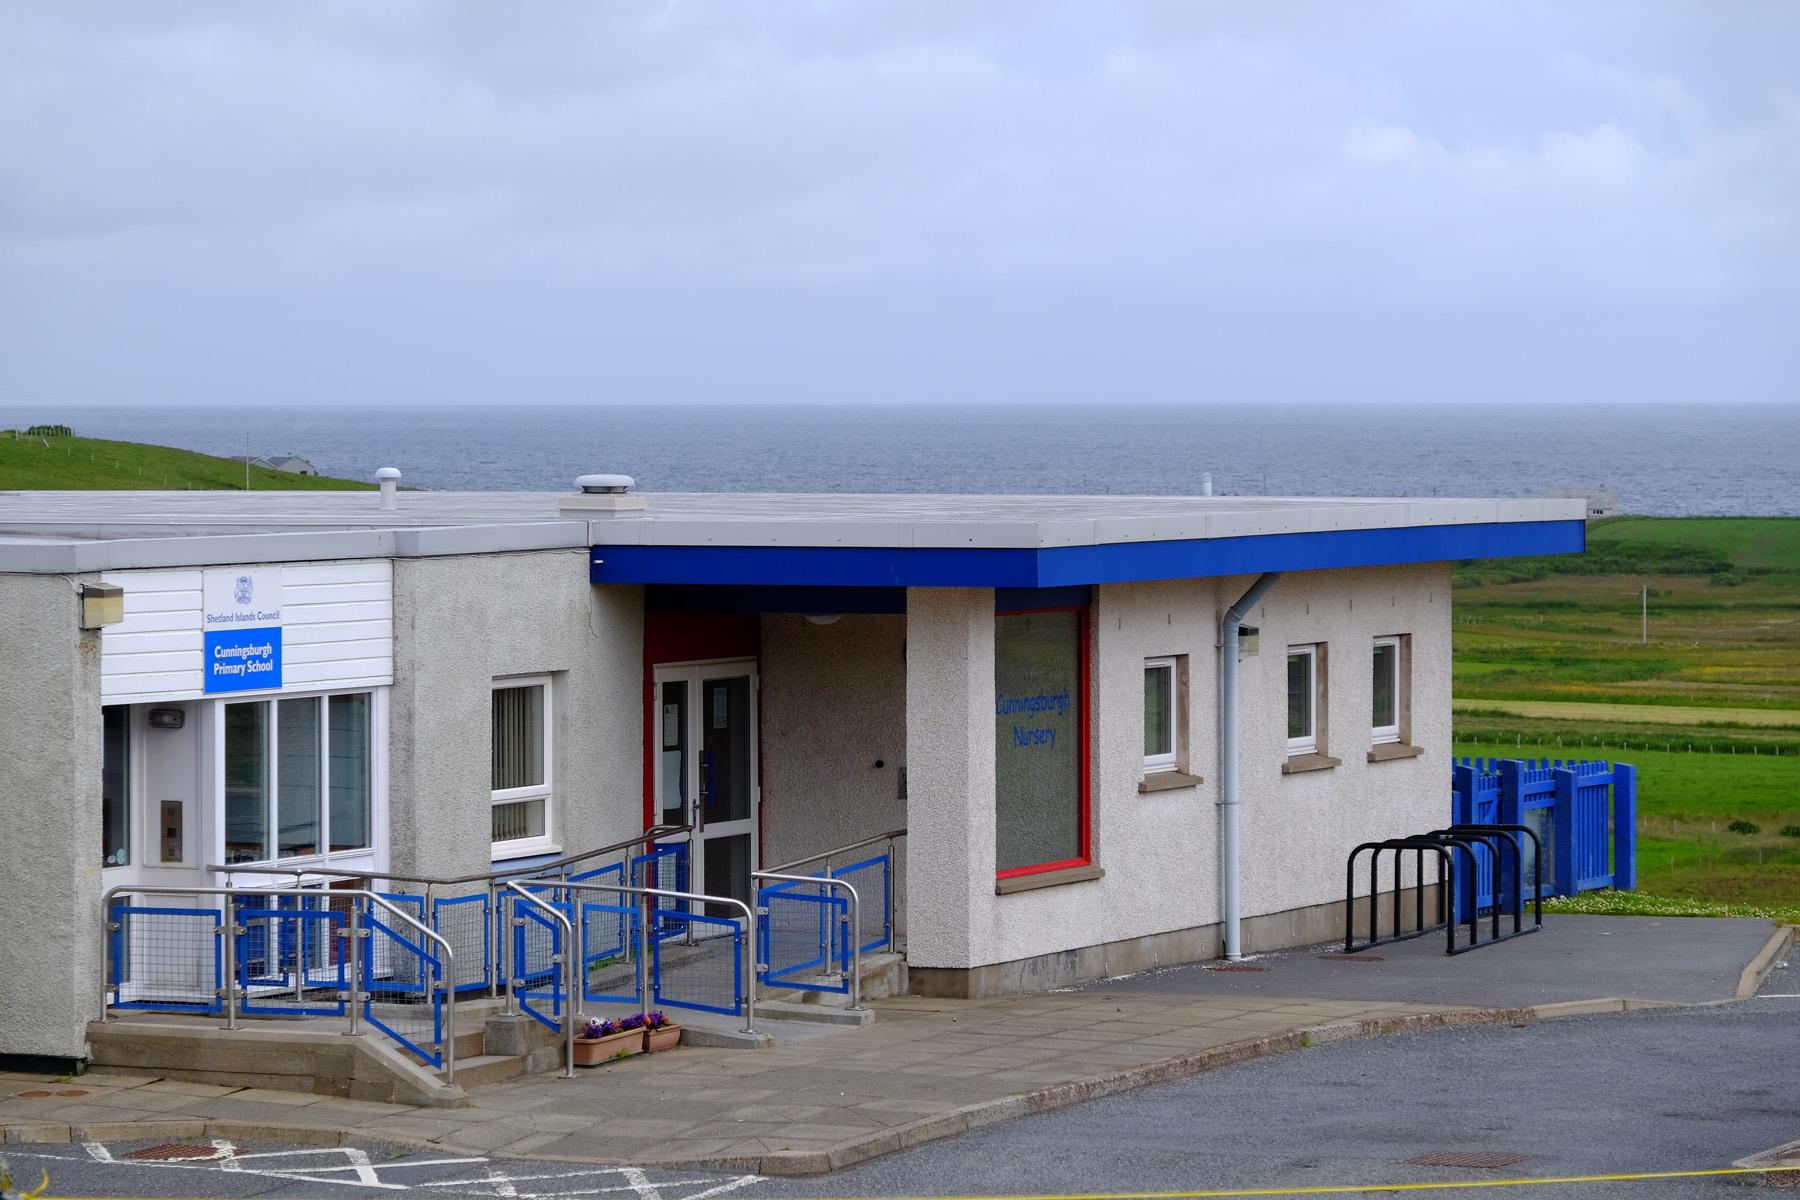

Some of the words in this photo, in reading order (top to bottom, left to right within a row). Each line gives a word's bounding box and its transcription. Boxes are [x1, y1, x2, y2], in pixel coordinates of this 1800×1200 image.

[206, 612, 234, 623] Shetland
[235, 612, 256, 621] Islands
[257, 610, 280, 621] Council
[214, 642, 273, 660] Cunningsburgh
[213, 662, 246, 677] Primary
[247, 659, 273, 673] School
[996, 688, 1070, 719] Cunningsburgh
[1013, 724, 1057, 751] Nursery
